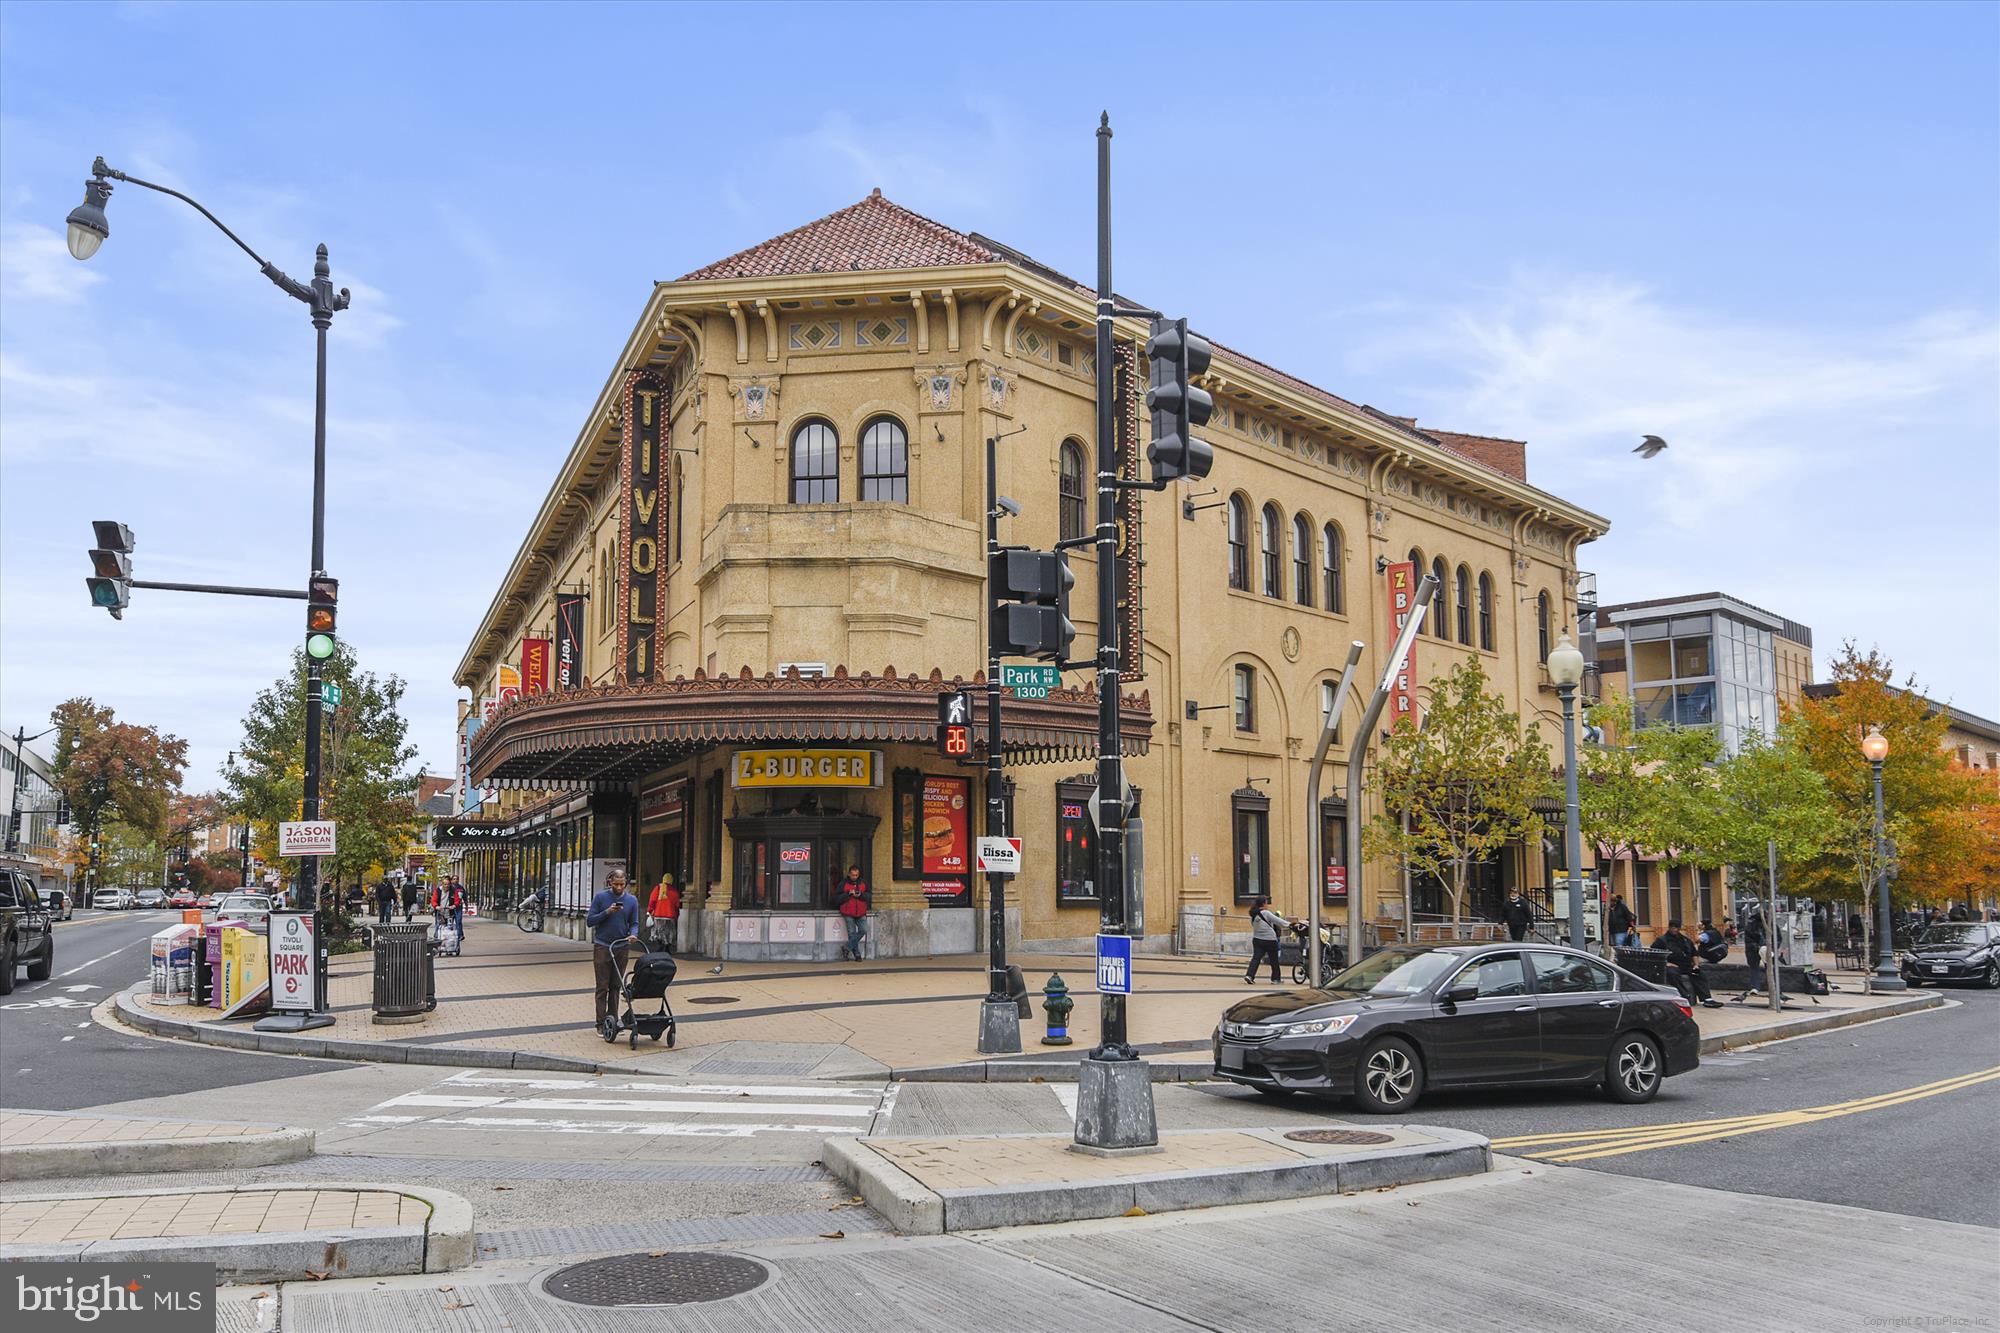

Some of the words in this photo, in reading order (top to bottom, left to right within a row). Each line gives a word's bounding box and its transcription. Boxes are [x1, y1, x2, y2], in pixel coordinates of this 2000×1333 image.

[630, 389, 657, 674] TIVOLI
[1394, 572, 1406, 588] Z
[1395, 593, 1410, 712] BUGER
[560, 639, 573, 686] verizon
[529, 645, 542, 695] WELL
[1006, 668, 1039, 684] Park
[1016, 687, 1046, 698] 1300
[321, 701, 335, 713] 3300
[947, 729, 966, 753] 26
[741, 757, 865, 778] Z-BURGER
[1083, 774, 1100, 784] TIV
[286, 826, 331, 837] JASON
[462, 827, 484, 836] Nov
[491, 827, 506, 836] 8-1
[286, 836, 331, 844] ANDREAN
[781, 850, 809, 862] OPEN
[983, 847, 1014, 858] Elissa
[280, 944, 304, 952] SQUARE
[274, 953, 309, 975] PARK
